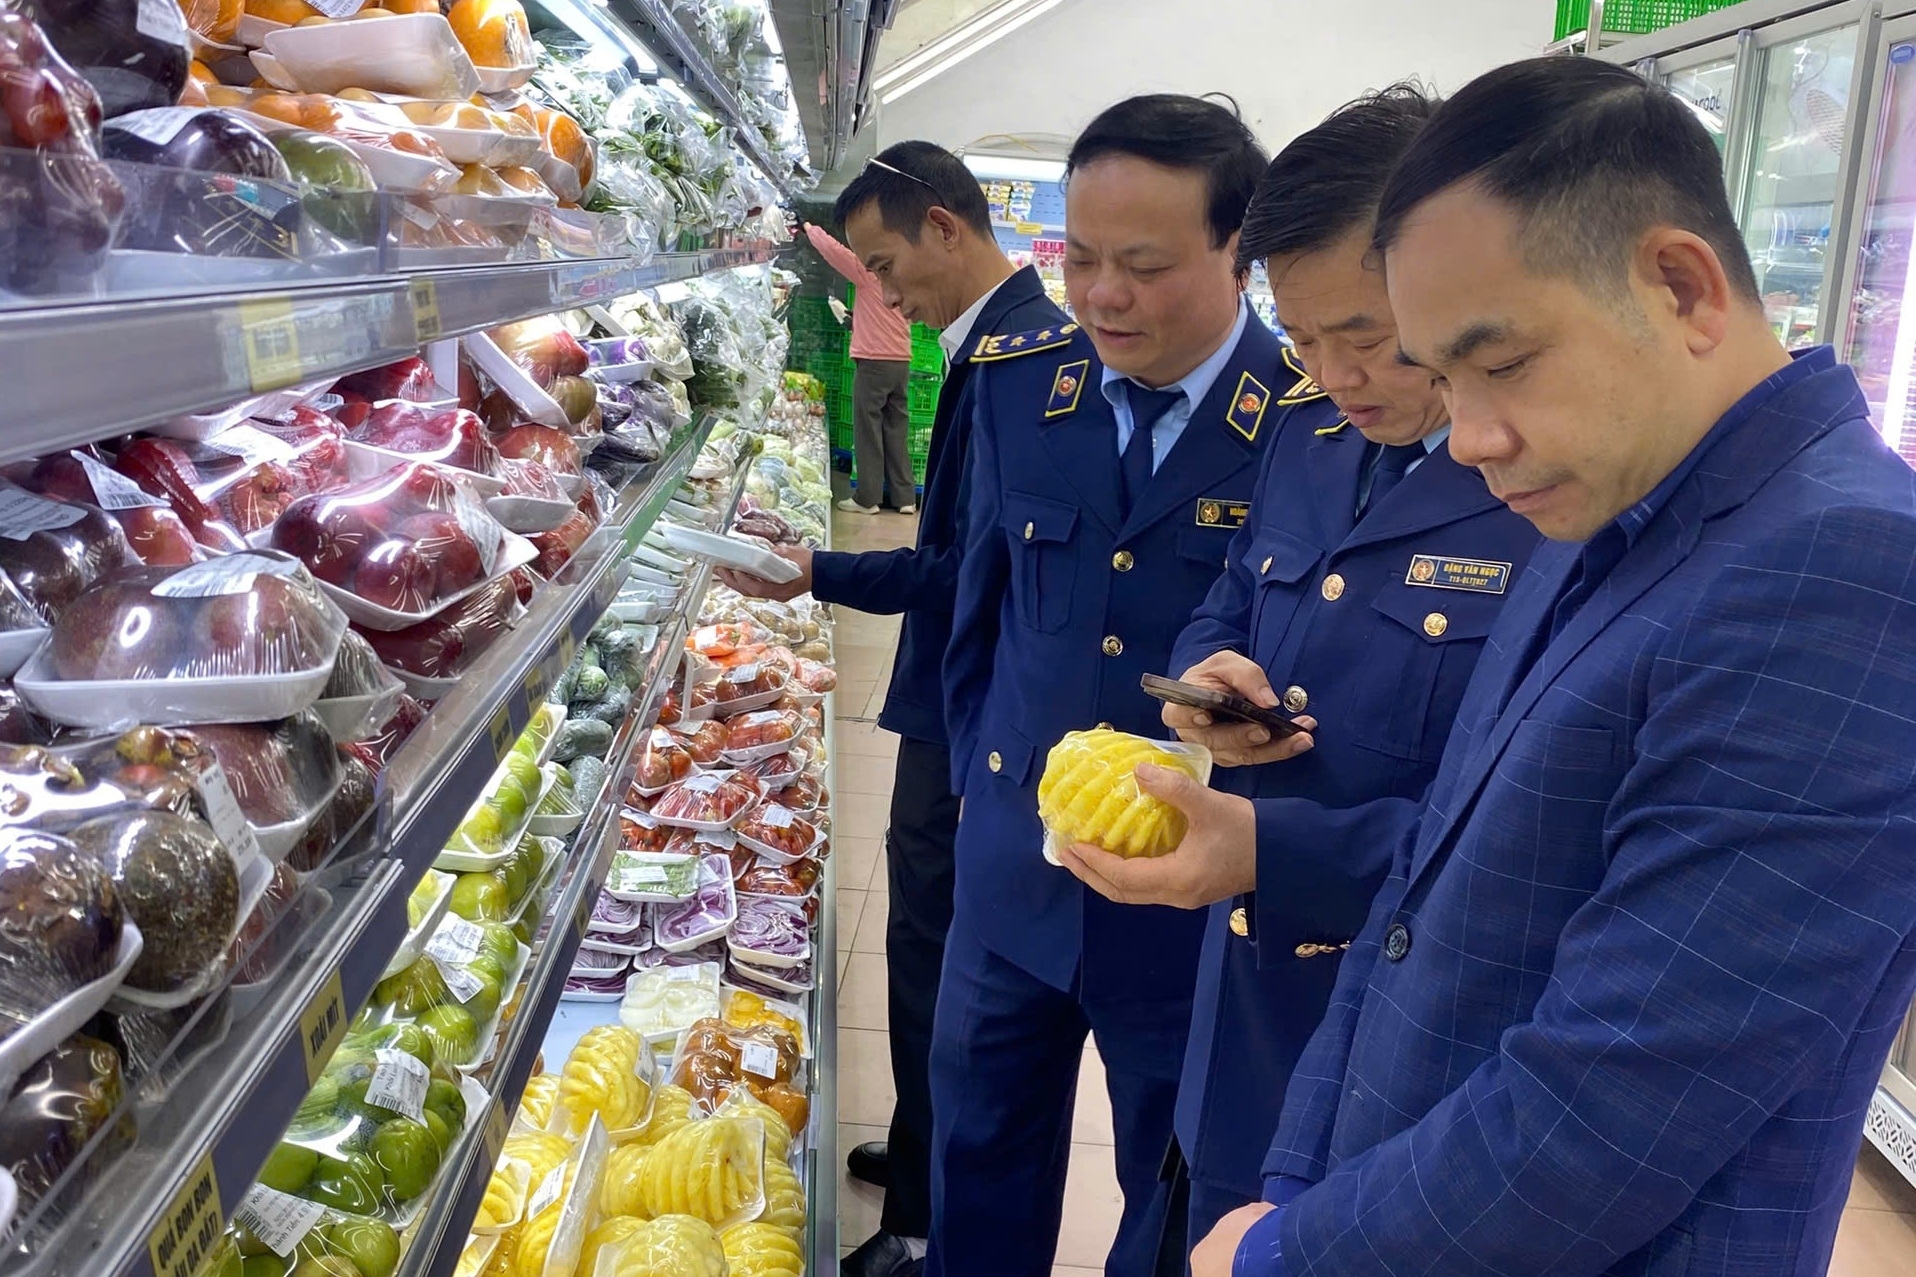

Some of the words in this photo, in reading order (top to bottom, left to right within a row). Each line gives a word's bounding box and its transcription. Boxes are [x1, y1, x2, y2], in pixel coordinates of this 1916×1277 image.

[1464, 564, 1479, 575] VĂN
[176, 1198, 195, 1242] BON
[194, 1171, 212, 1213] BON
